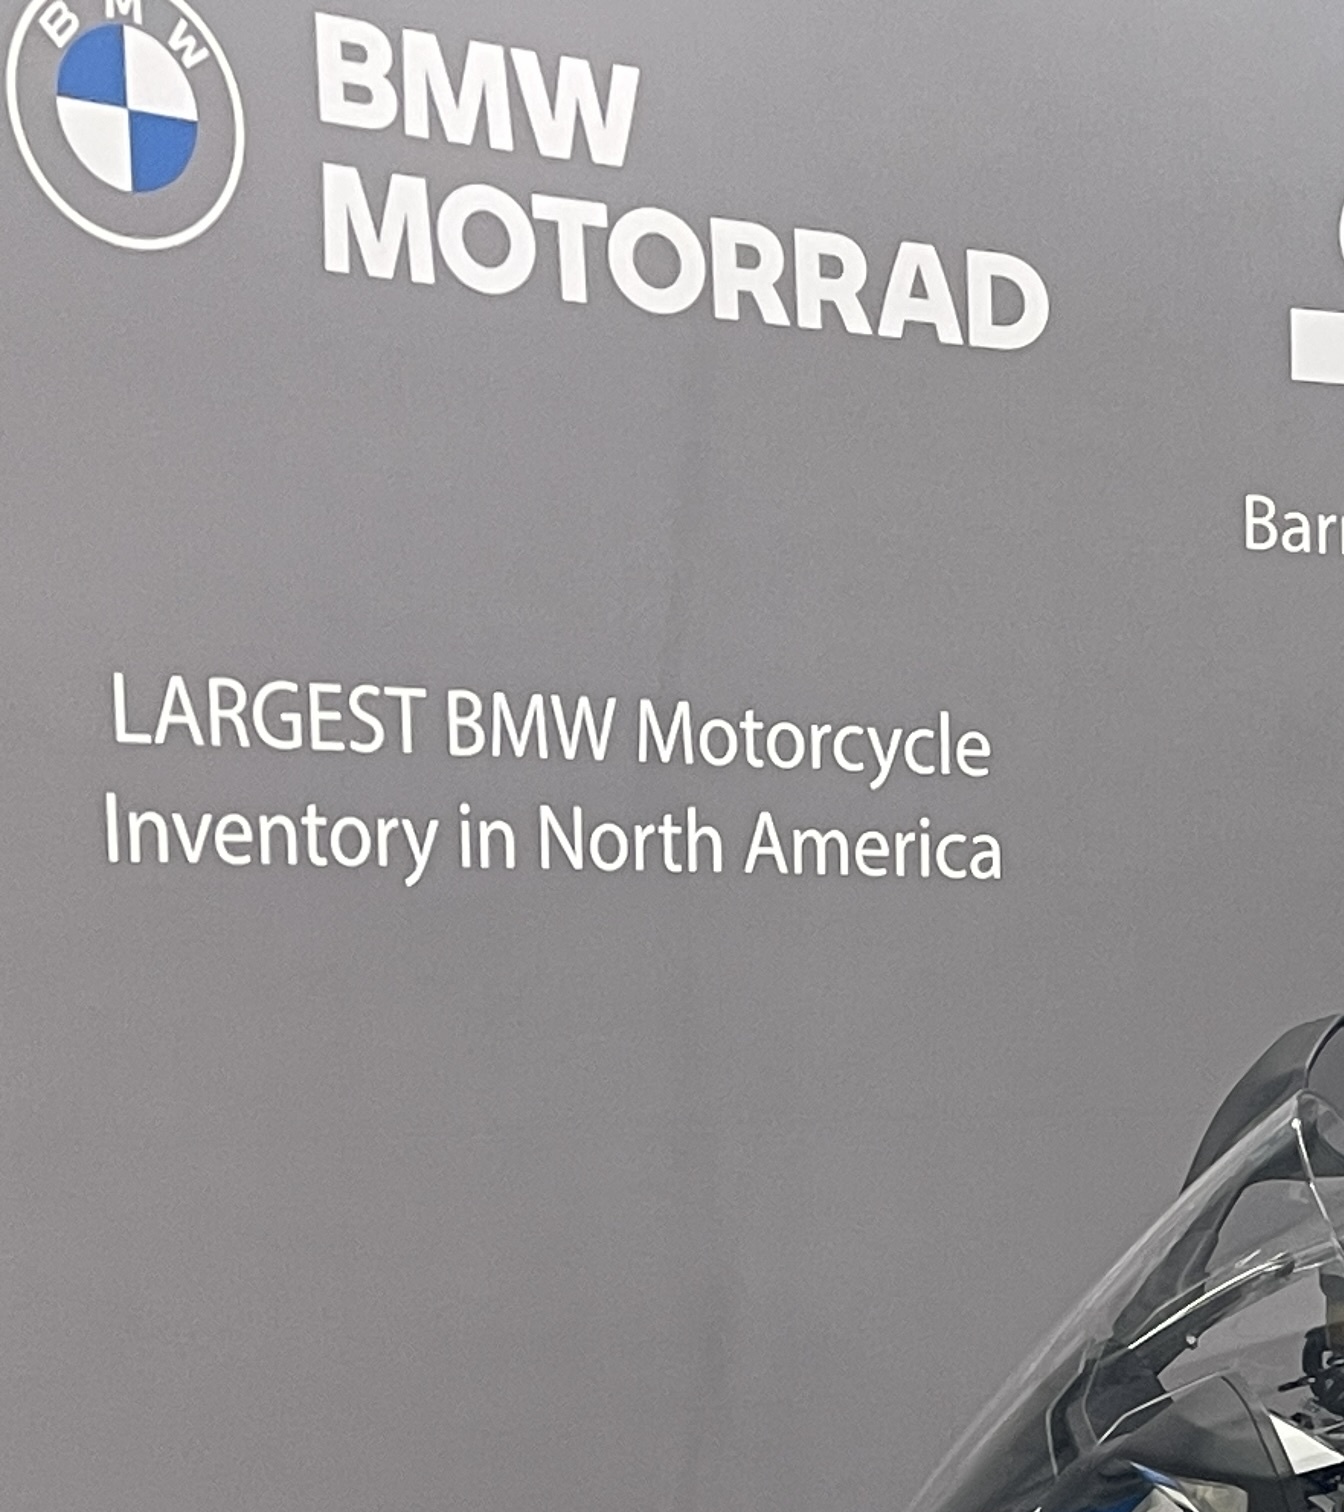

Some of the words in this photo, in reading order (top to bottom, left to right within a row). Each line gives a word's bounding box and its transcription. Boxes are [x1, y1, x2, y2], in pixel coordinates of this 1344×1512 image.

[314, 11, 641, 167] BMW
[322, 162, 1050, 350] MOTORRAD
[113, 671, 427, 754] LARGEST
[447, 689, 617, 761] BMW
[638, 698, 991, 791] Motorcycle
[105, 791, 439, 888] Inventory
[459, 802, 516, 869] in
[539, 804, 723, 873] North
[744, 811, 1001, 880] America
